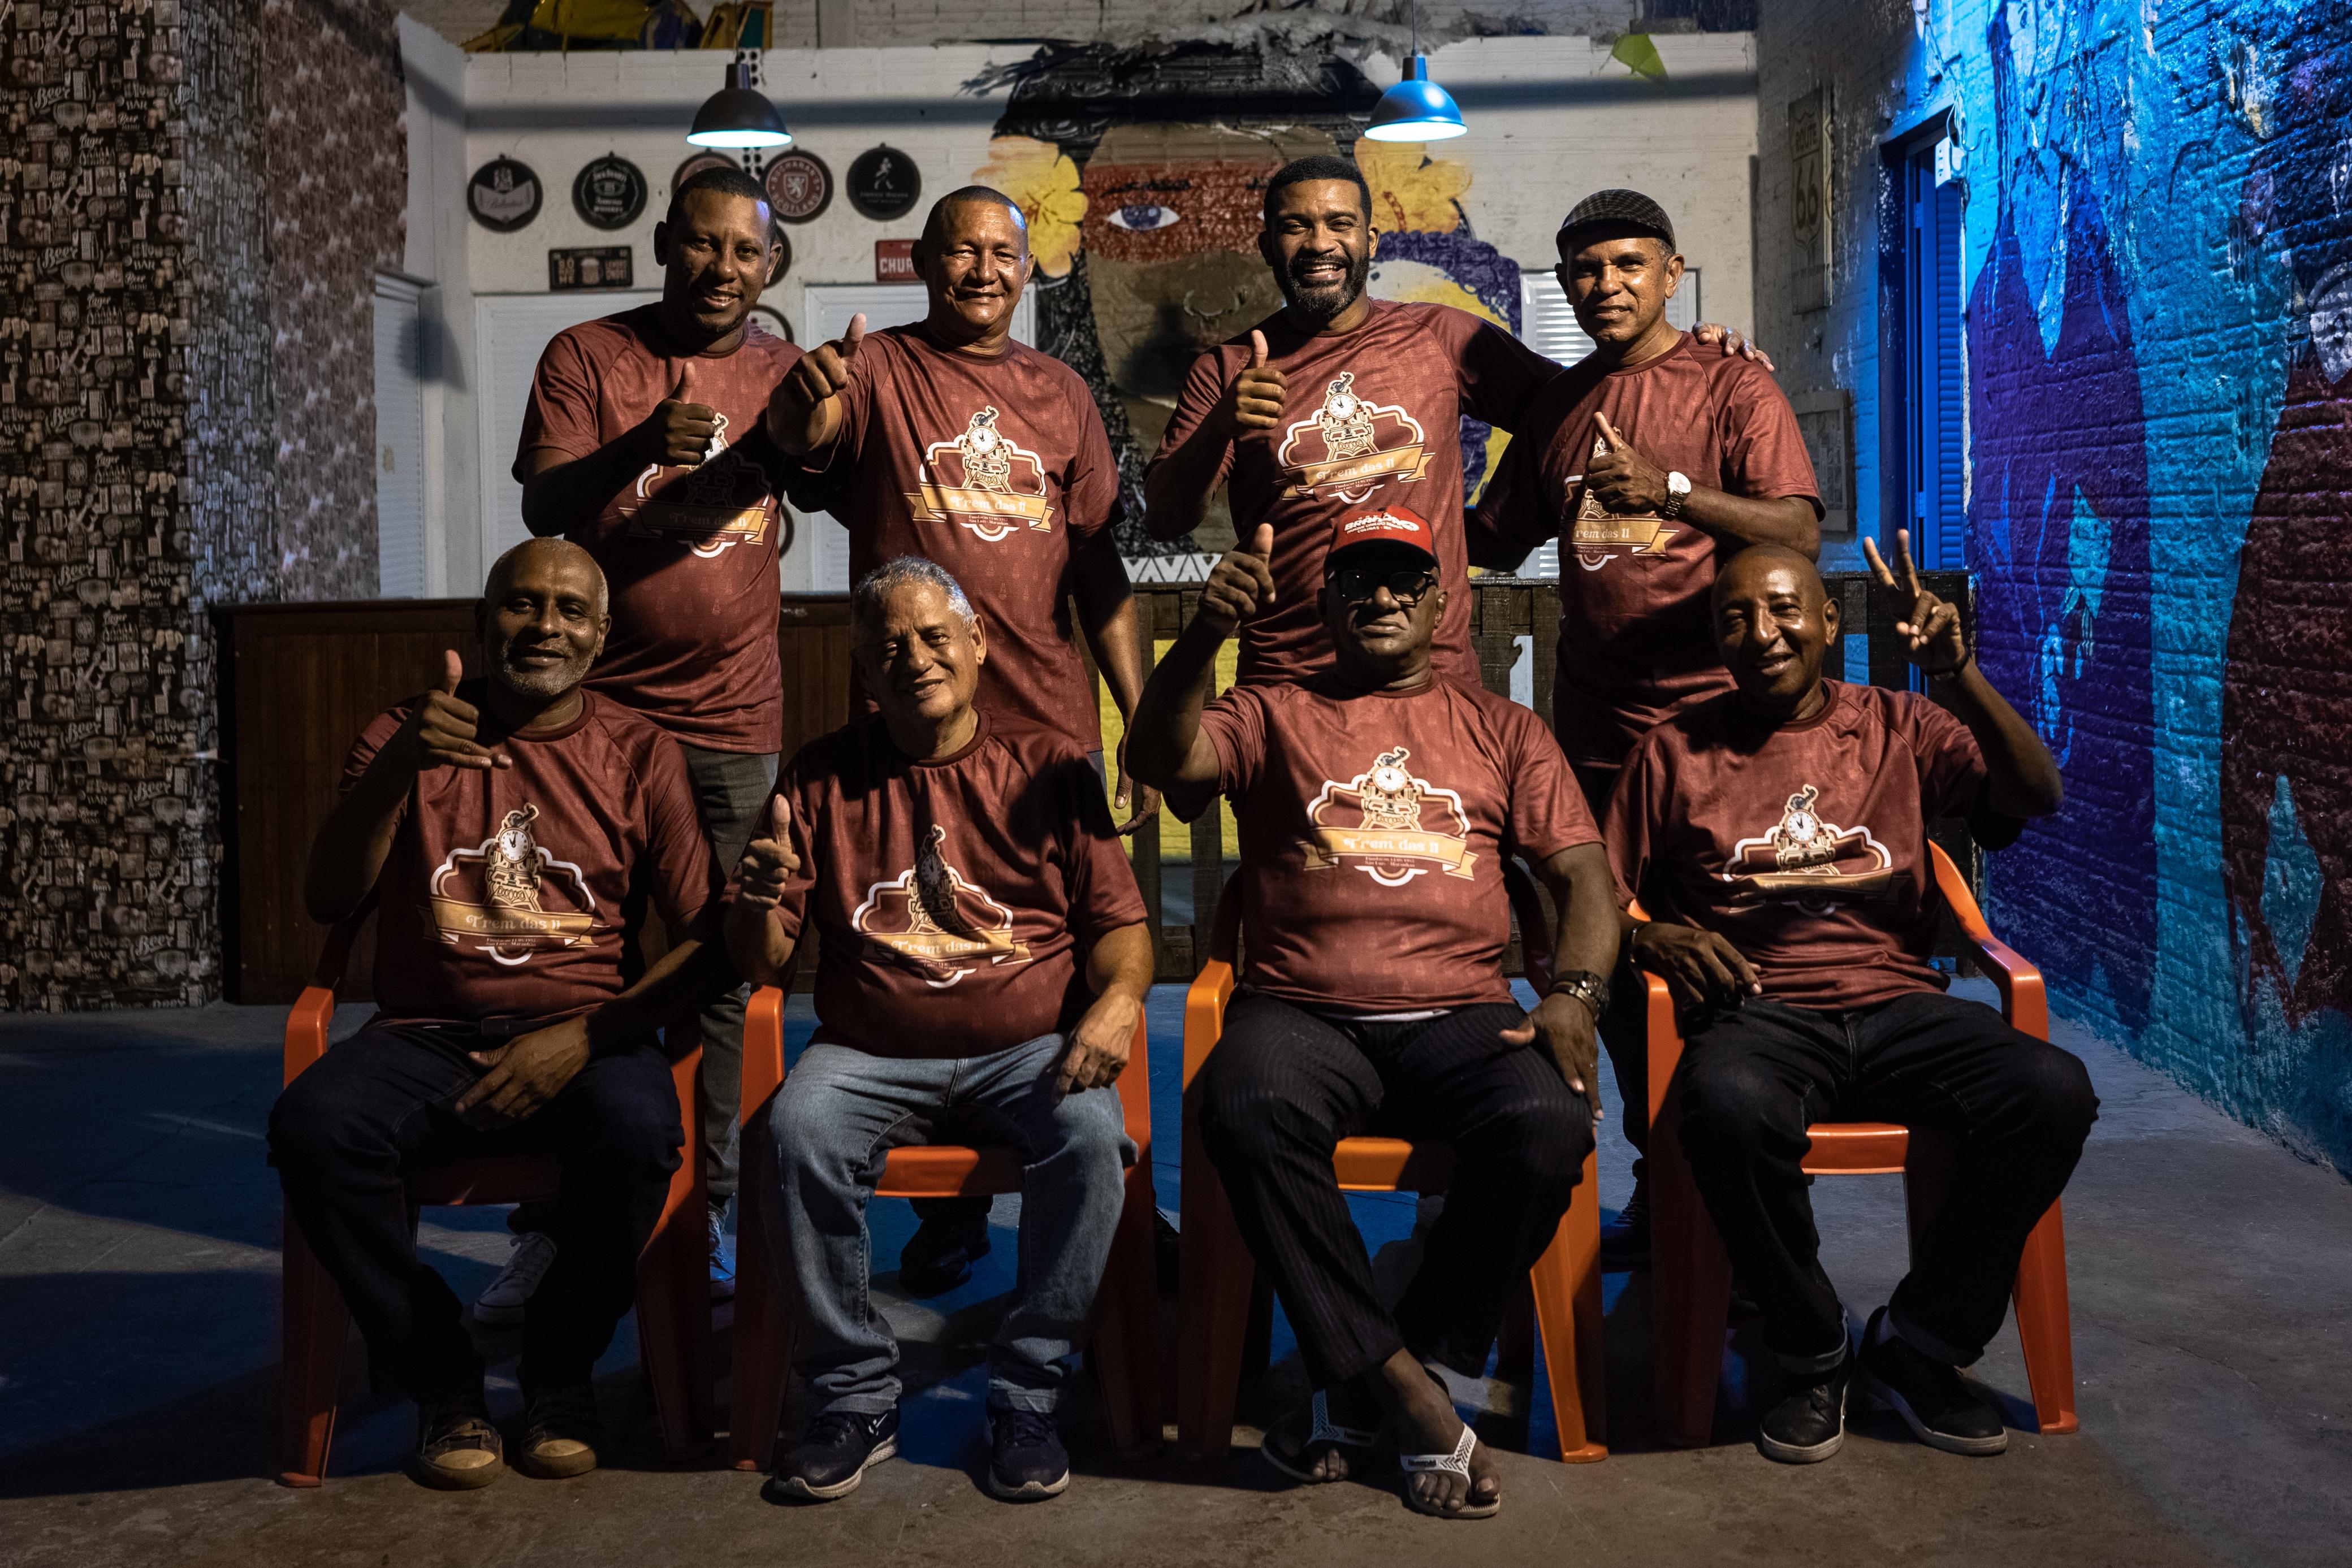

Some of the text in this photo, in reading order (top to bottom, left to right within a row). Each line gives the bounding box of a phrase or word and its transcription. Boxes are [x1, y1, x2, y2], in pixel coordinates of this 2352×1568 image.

[1795, 123, 1817, 153] ROUTE
[1795, 159, 1819, 229] 66
[1316, 467, 1357, 480] Trem
[950, 496, 991, 509] Trem
[1574, 526, 1599, 538] rem
[1343, 836, 1394, 850] Trem
[466, 915, 516, 930] Trem
[890, 939, 941, 955] Trem
